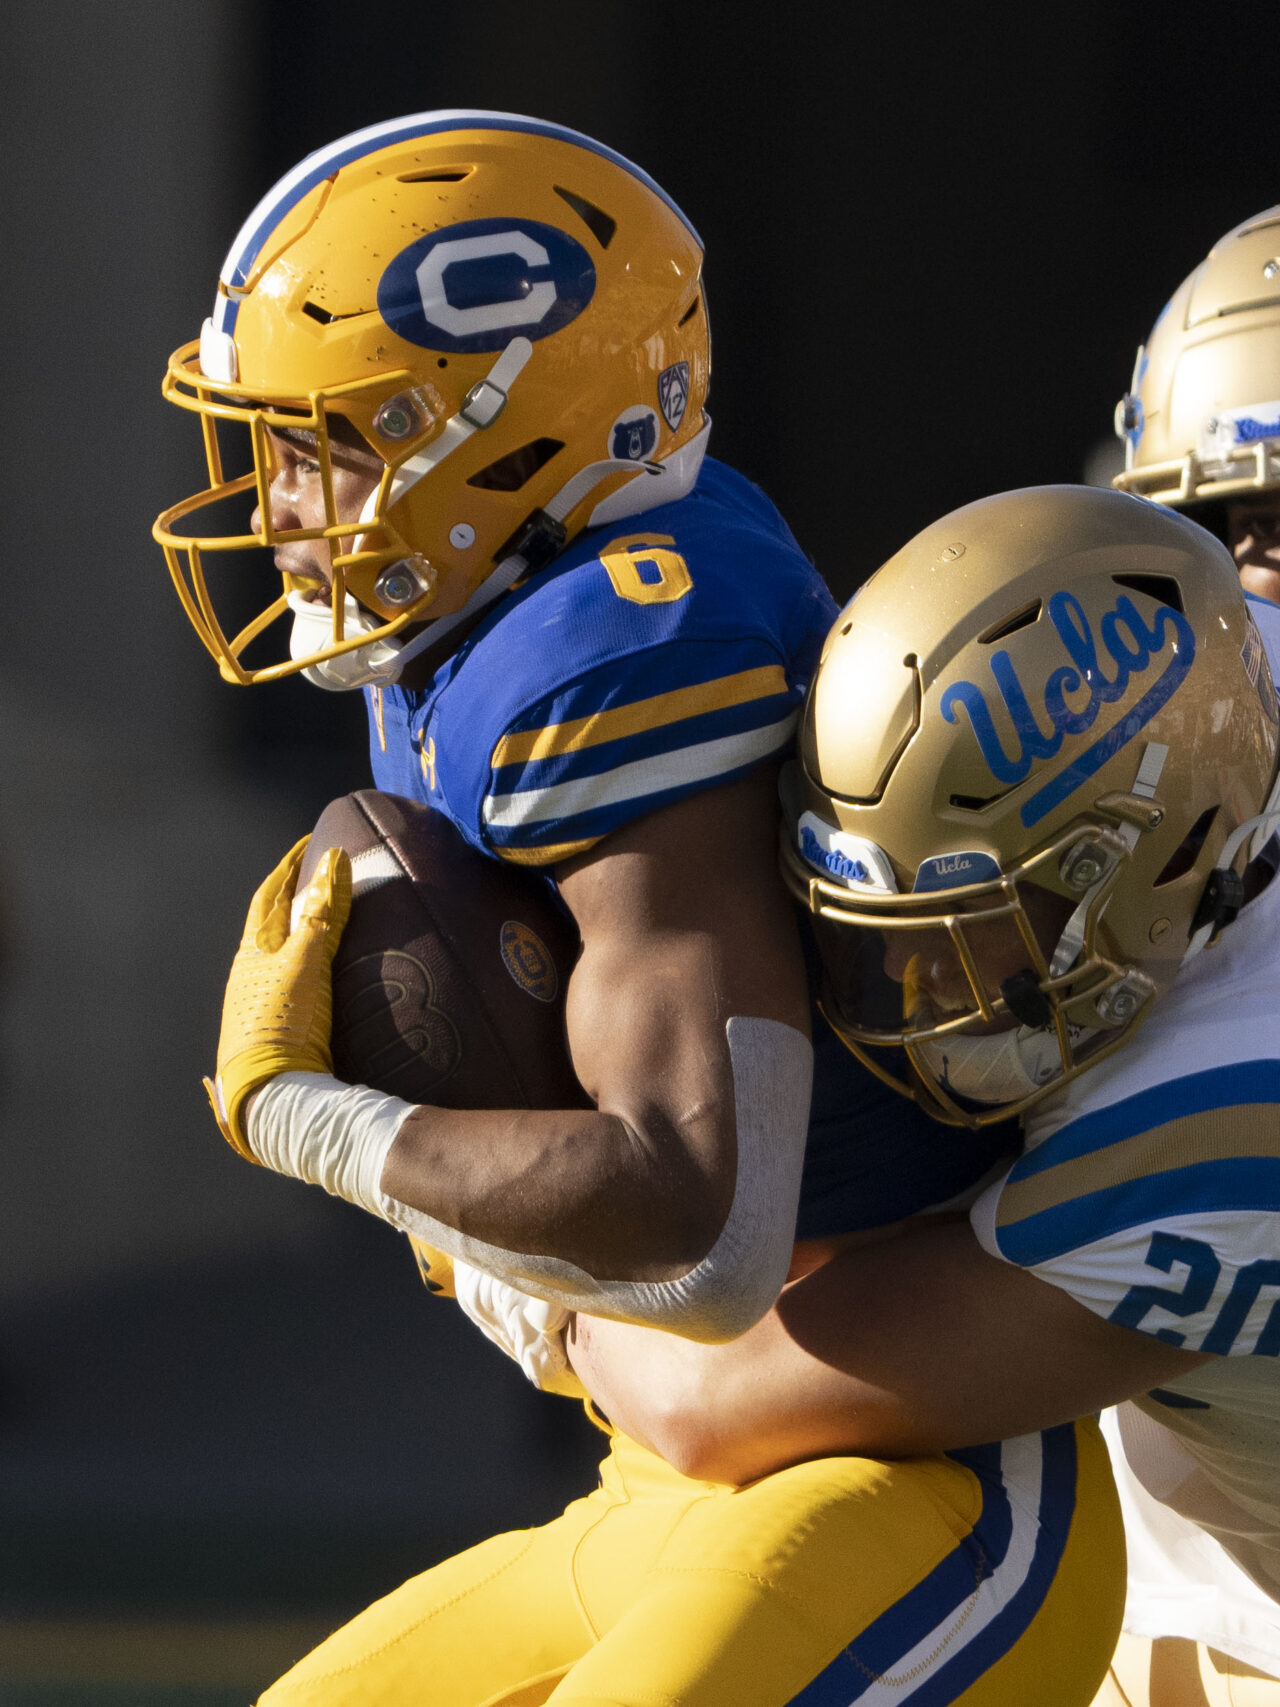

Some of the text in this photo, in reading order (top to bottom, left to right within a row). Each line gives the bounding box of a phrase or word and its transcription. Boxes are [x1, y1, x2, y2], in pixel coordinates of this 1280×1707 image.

[415, 230, 558, 337] C
[598, 532, 694, 606] 6
[940, 590, 1196, 800] Ucla
[932, 855, 972, 875] Ucla
